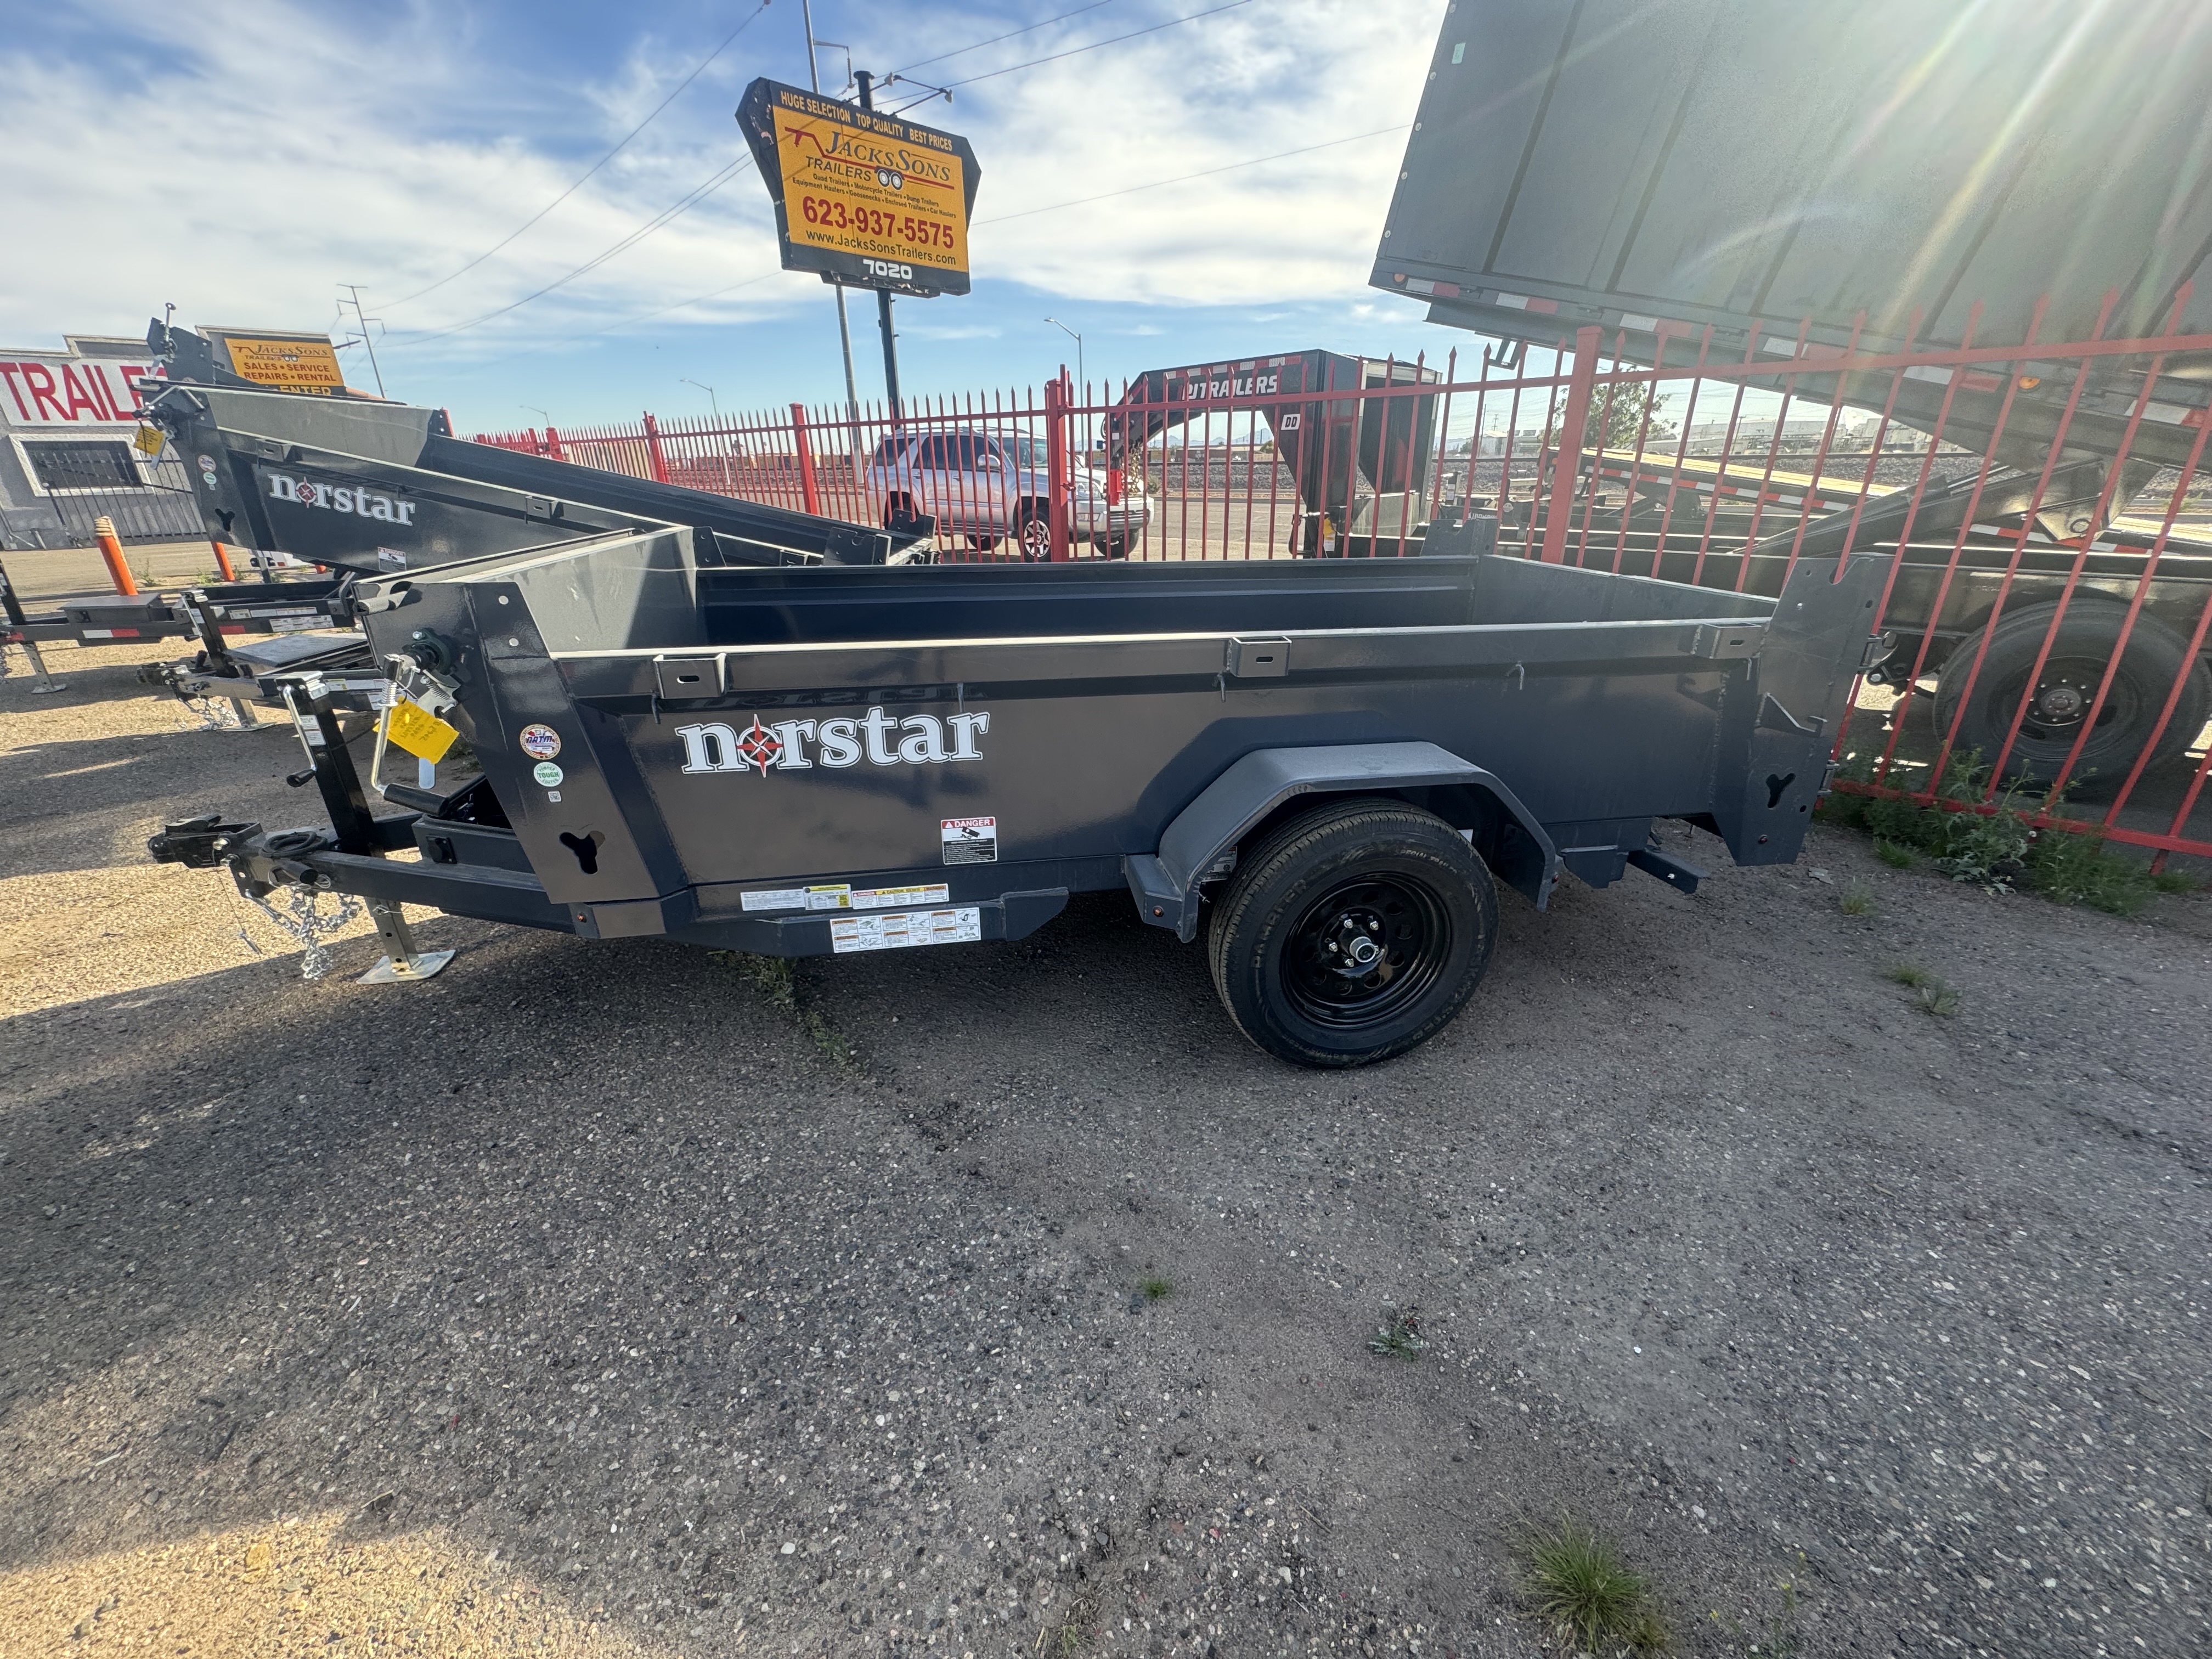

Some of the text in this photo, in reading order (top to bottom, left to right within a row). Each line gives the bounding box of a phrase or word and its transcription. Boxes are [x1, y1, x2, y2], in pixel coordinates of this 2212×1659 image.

[781, 91, 953, 151] HUGE SELECTION TOP QUALITY BEST PRICES
[806, 155, 871, 182] TRAILERS
[793, 177, 823, 189] Equipment
[824, 184, 845, 194] Haulers
[850, 190, 881, 202] Goosenecks
[885, 198, 907, 207] Enclosed
[908, 202, 926, 212] Trailers
[813, 173, 939, 207] Quad Trailers Motorcycle Trailers Dump Trailers
[803, 196, 953, 249] 623-937-5575
[806, 230, 956, 265] www.JacksSonsTrailers.com
[863, 259, 912, 280] 7020
[244, 362, 330, 372] SALES SERVICE
[244, 372, 289, 380] REPAIRS
[267, 473, 415, 526] norstar
[675, 706, 990, 774] norstar
[955, 819, 990, 828] DANGER
